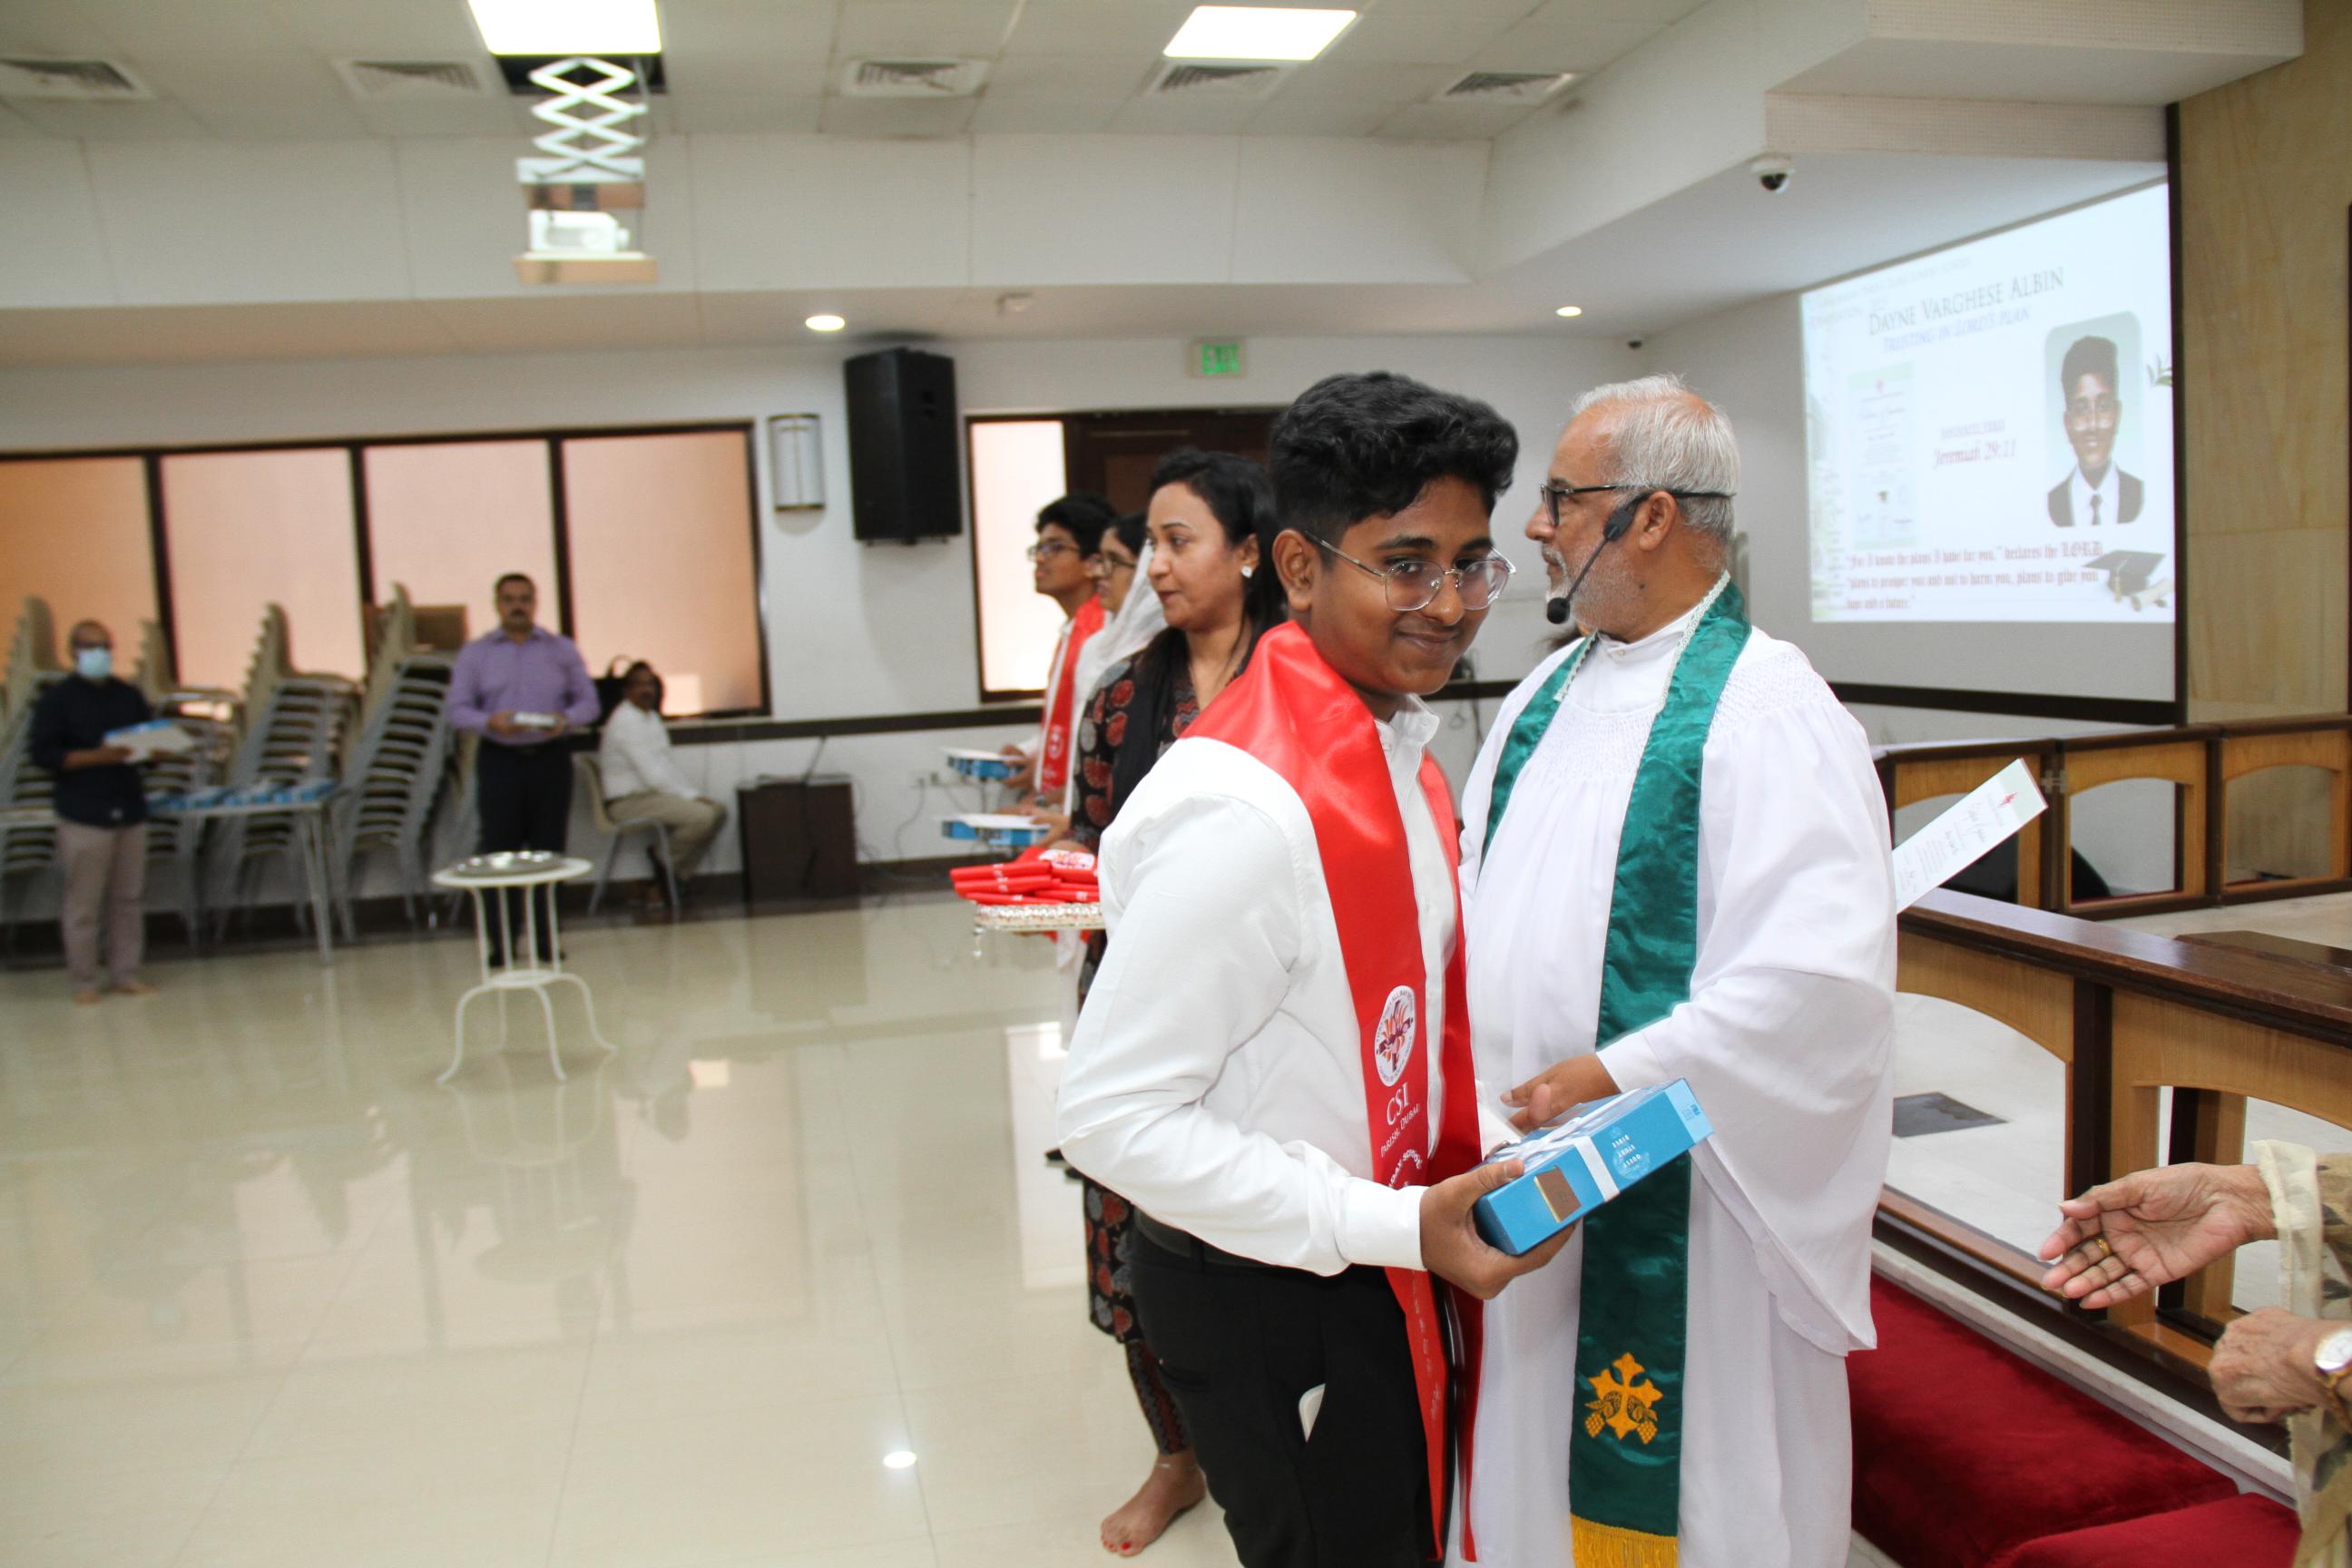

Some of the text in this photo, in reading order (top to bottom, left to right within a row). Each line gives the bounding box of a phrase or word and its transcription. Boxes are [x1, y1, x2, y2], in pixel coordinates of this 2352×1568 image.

[1868, 306, 1916, 336] DAYNE
[1921, 282, 2004, 320] VARGHESE
[2009, 267, 2065, 299] ALBIN
[1387, 1082, 1408, 1126] CSI
